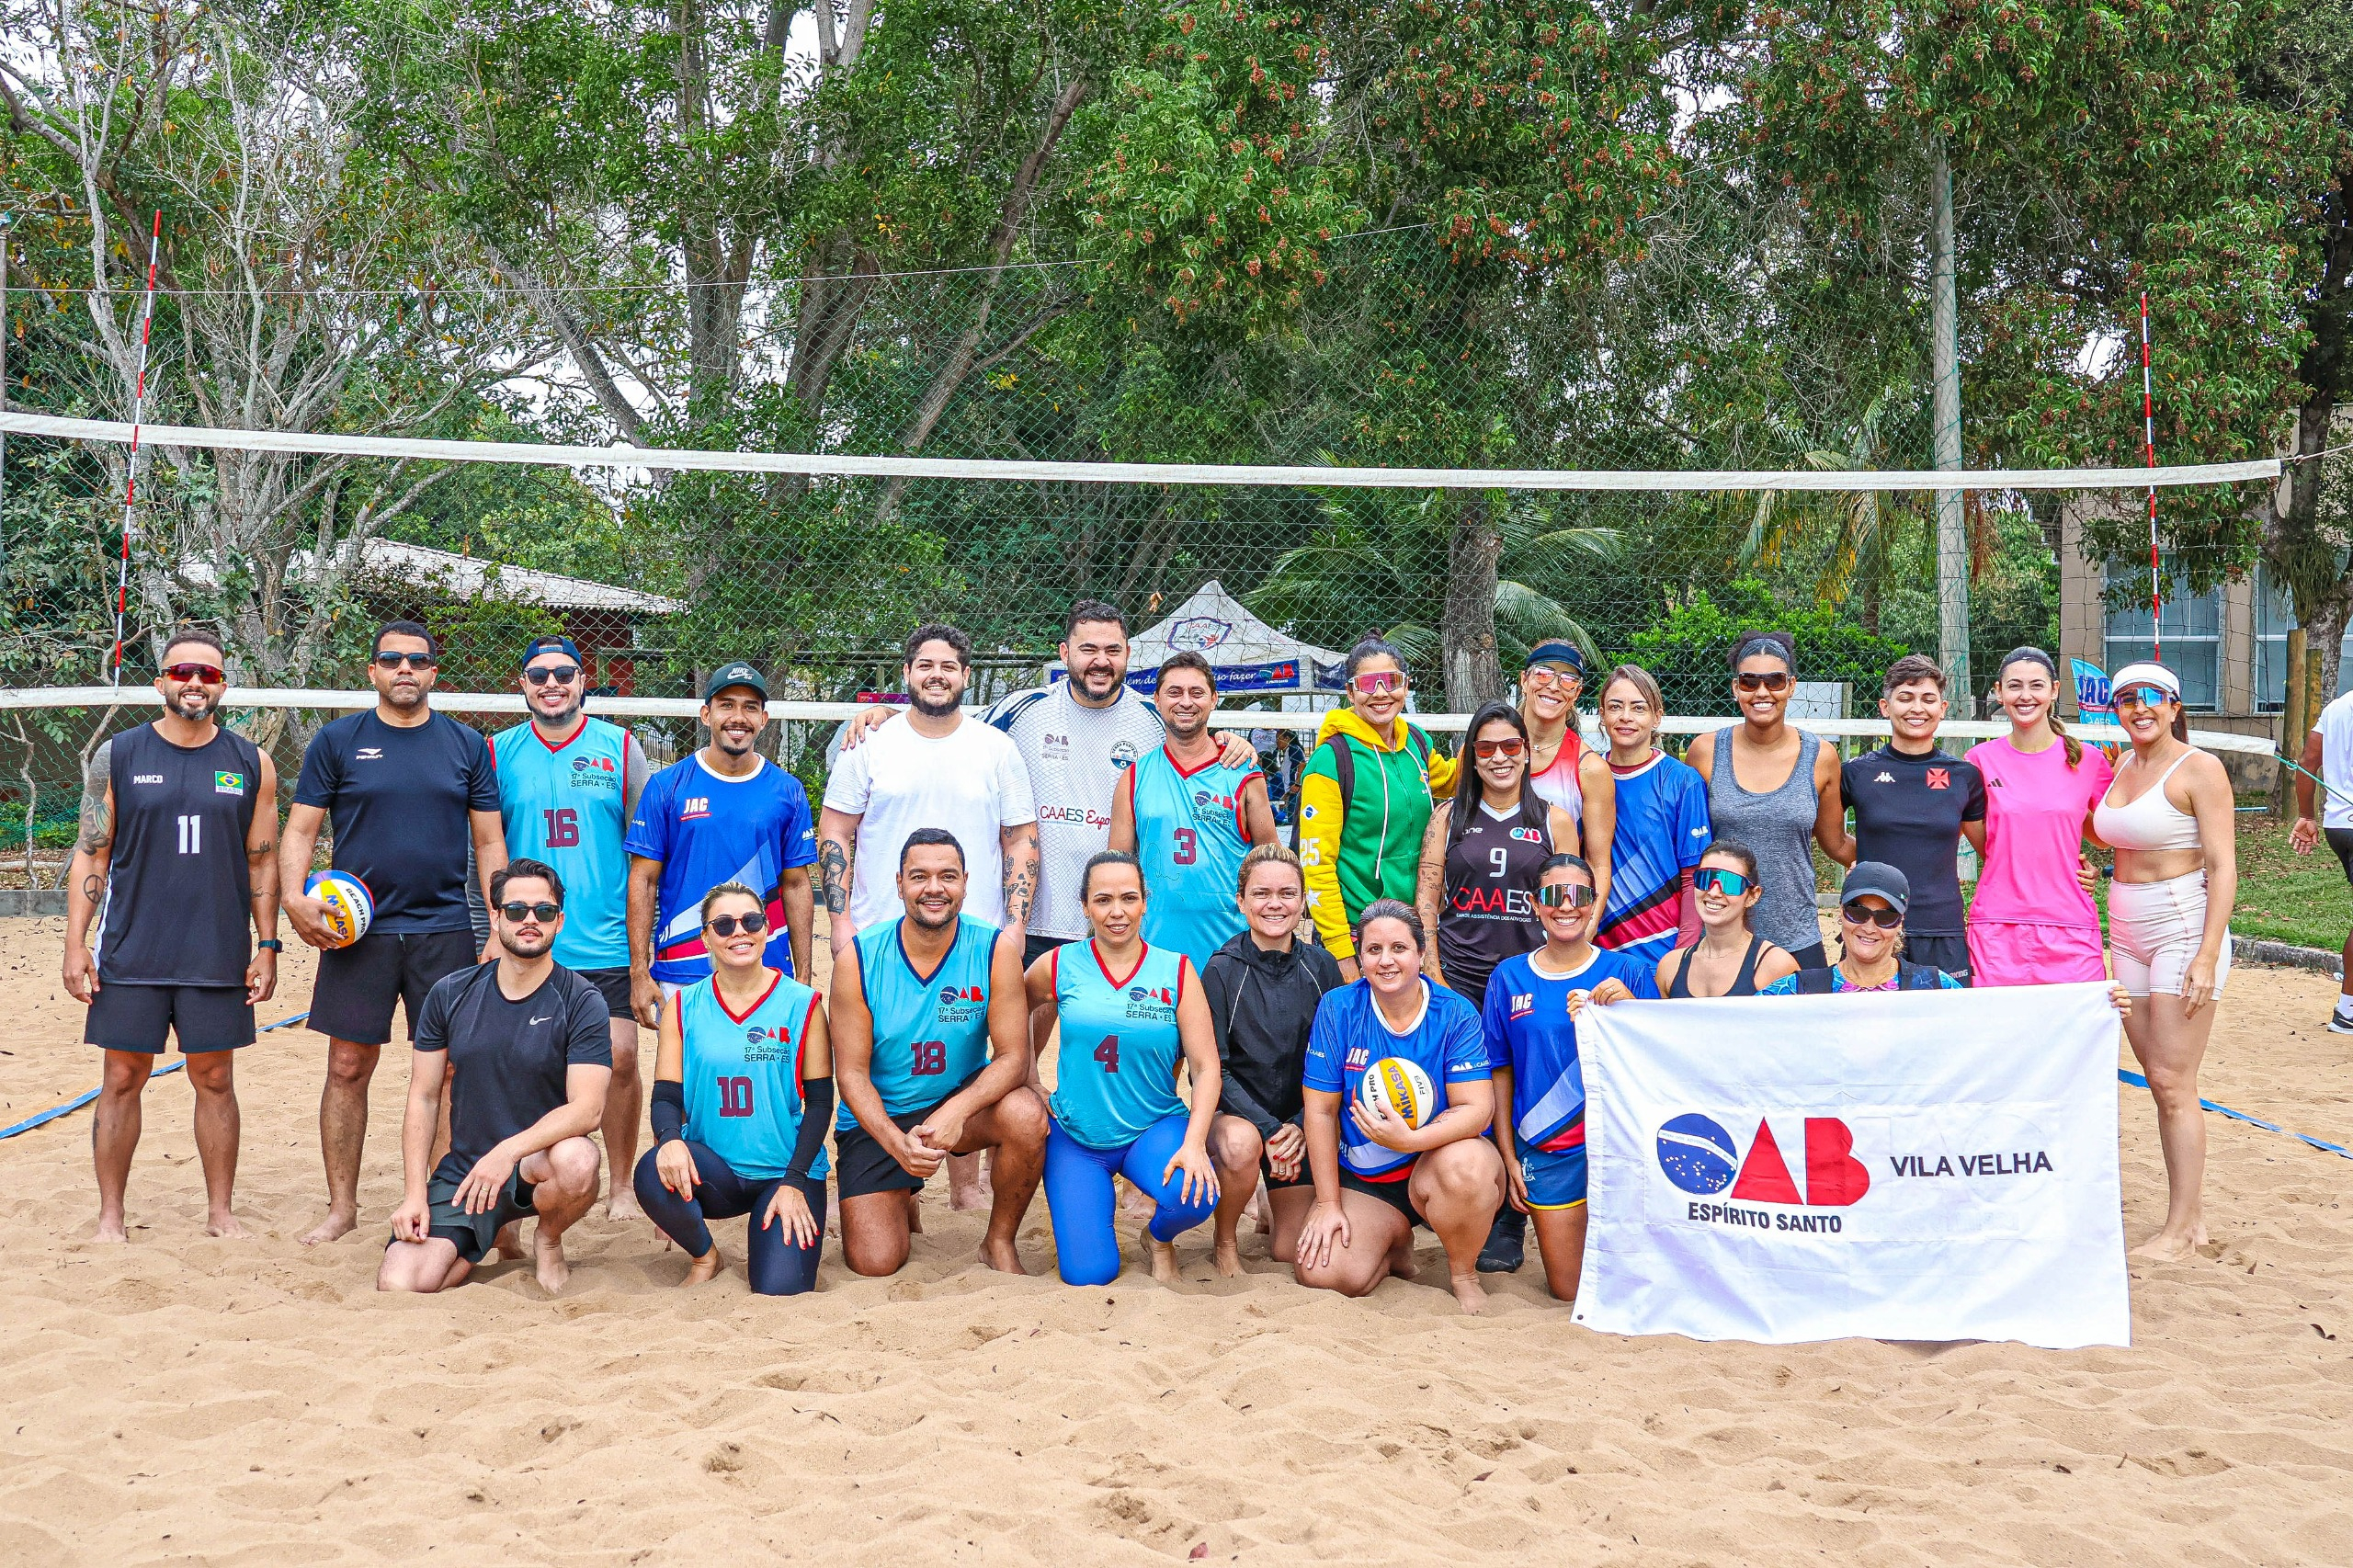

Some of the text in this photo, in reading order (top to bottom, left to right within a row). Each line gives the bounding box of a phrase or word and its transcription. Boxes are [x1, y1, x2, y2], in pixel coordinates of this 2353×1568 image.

[1123, 675, 1157, 687] lém de
[1229, 671, 1256, 685] fazer
[2078, 675, 2109, 705] JAC
[133, 775, 164, 785] MARCO
[218, 786, 242, 795] BRASIL
[571, 779, 617, 790] SERRA ES
[683, 797, 709, 814] JAC
[1040, 805, 1110, 830] CAAES Espo
[543, 808, 580, 848] 16
[1192, 813, 1218, 824] SERRA
[177, 814, 200, 855] 11
[1173, 827, 1197, 865] 3
[1510, 827, 1542, 844] OAB
[1300, 837, 1320, 867] 25
[1489, 847, 1507, 878] 9
[346, 888, 365, 915] BEACH
[1453, 887, 1532, 915] CAAES
[325, 894, 349, 940] MASA
[1511, 993, 1533, 1013] JAC
[938, 1010, 985, 1023] SERRA ES
[1125, 1010, 1172, 1022] SERRA ES
[744, 1054, 790, 1063] SERRA ES
[910, 1040, 947, 1076] 18
[1093, 1034, 1120, 1074] 4
[1346, 1047, 1370, 1065] JAC
[1369, 1074, 1377, 1093] PRO
[1388, 1064, 1415, 1119] MIKASA
[1414, 1075, 1426, 1096] FIVB
[717, 1075, 754, 1118] 10
[1656, 1112, 1870, 1207] OAB
[1890, 1151, 2053, 1176] VILA VELHA
[1688, 1200, 1842, 1233] ESPÍRITO SANTO
